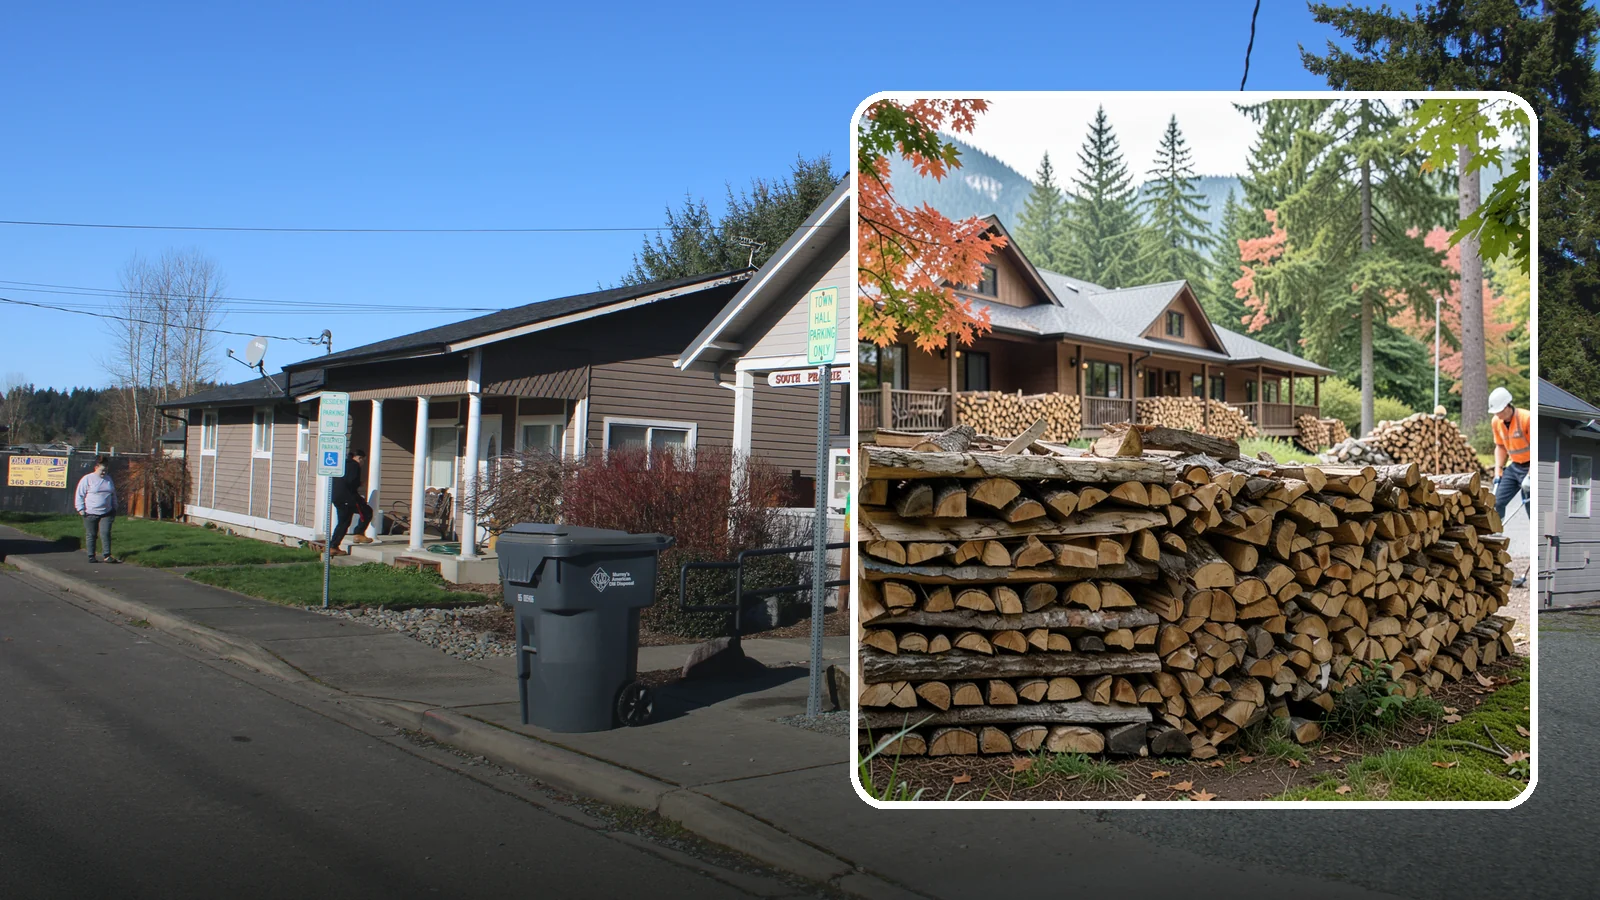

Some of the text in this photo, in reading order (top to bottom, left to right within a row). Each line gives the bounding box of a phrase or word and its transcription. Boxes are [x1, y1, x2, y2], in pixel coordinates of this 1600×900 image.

[815, 295, 833, 307] TOWN
[814, 312, 831, 324] HALL
[810, 327, 836, 340] PARKING
[813, 344, 831, 357] ONLY
[775, 373, 801, 384] SOUTH
[808, 371, 842, 382] PRIE
[325, 420, 340, 428] ONLY
[10, 479, 65, 487] 360-897-8625
